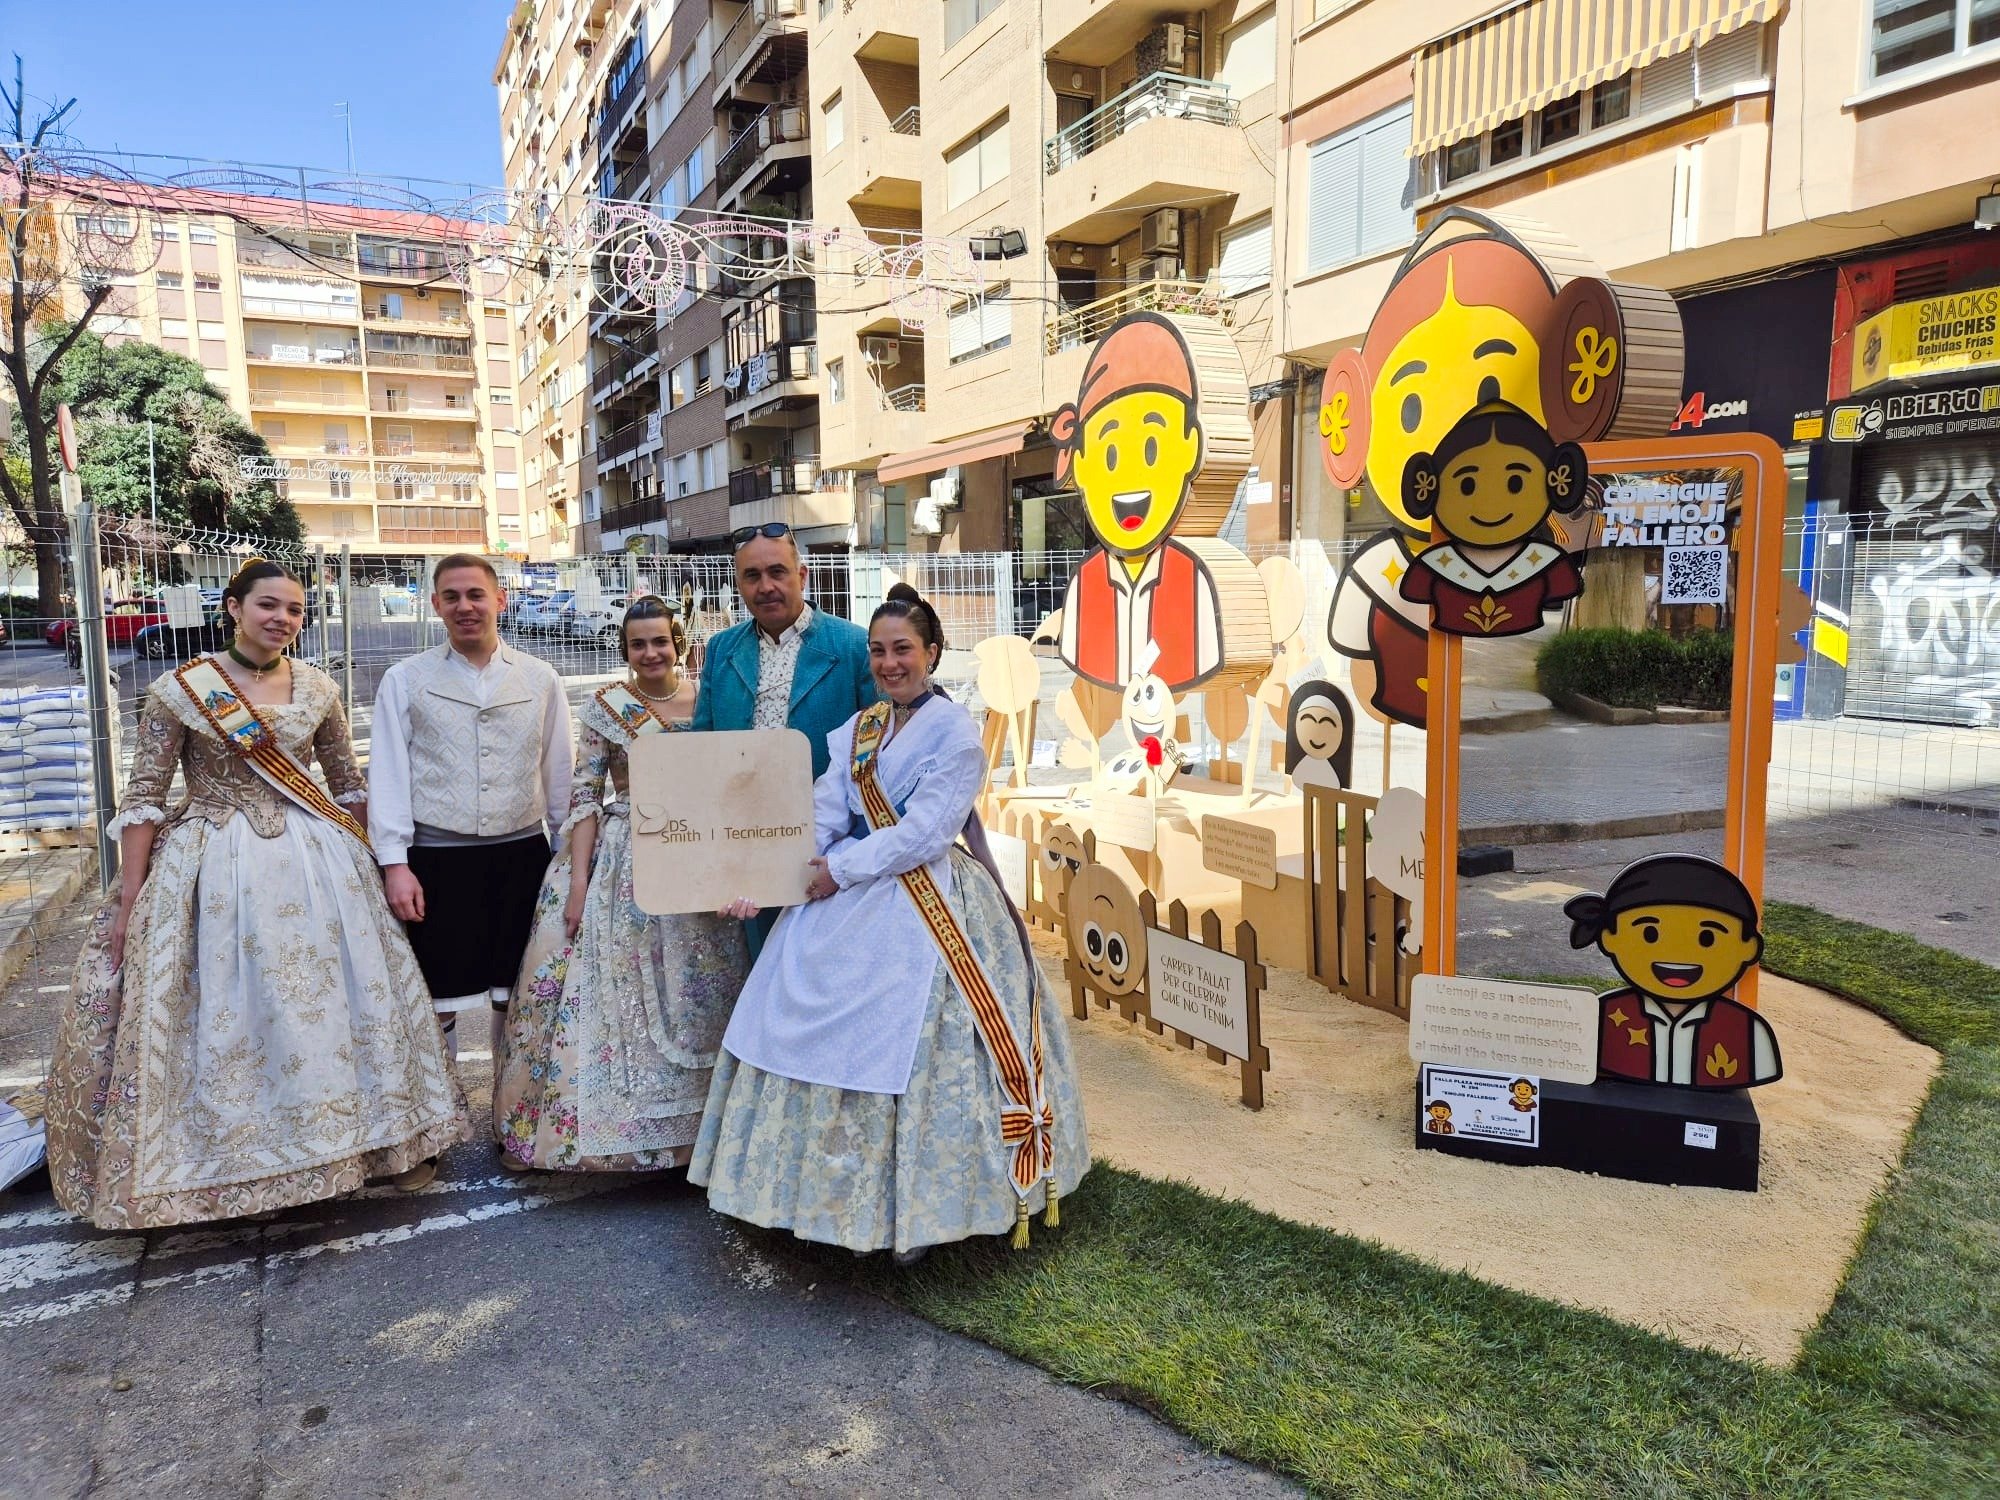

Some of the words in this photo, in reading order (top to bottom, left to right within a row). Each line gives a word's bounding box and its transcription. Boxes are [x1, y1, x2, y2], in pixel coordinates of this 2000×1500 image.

[1919, 291, 1999, 325] SNACKS
[1918, 315, 1997, 343] CHUCHES
[1917, 339, 1962, 356] Bebidas
[1669, 391, 1748, 431] 4.COM
[1885, 422, 1944, 440] SIEMPRE
[1603, 482, 1729, 505] CONSIGUE
[1602, 506, 1636, 526] TU
[1642, 503, 1726, 525] EMOJI
[1601, 524, 1726, 547] FALLERO
[660, 829, 701, 844] Smith
[669, 819, 688, 833] DS
[1160, 954, 1194, 976] CARRER
[1196, 966, 1231, 992] TALLAT
[1163, 971, 1180, 988] PER
[1182, 980, 1227, 1009] CELEBRAR
[1436, 982, 1478, 1000] L'emoji
[1482, 990, 1496, 1001] es
[1499, 993, 1515, 1003] un
[1518, 994, 1573, 1011] element,
[1161, 989, 1180, 1007] QUE
[1183, 998, 1199, 1014] NO
[1201, 1003, 1235, 1030] TENIM
[1425, 1002, 1447, 1016] que
[1449, 1007, 1471, 1018] ens
[1474, 1009, 1490, 1020] ve
[1492, 1011, 1500, 1021] a
[1503, 1012, 1583, 1034] acompanyar,
[1430, 1022, 1459, 1036] quan
[1462, 1025, 1493, 1040] obris
[1495, 1032, 1511, 1043] un
[1414, 1040, 1427, 1050] al
[1490, 1049, 1518, 1064] tens
[1520, 1054, 1545, 1068] que
